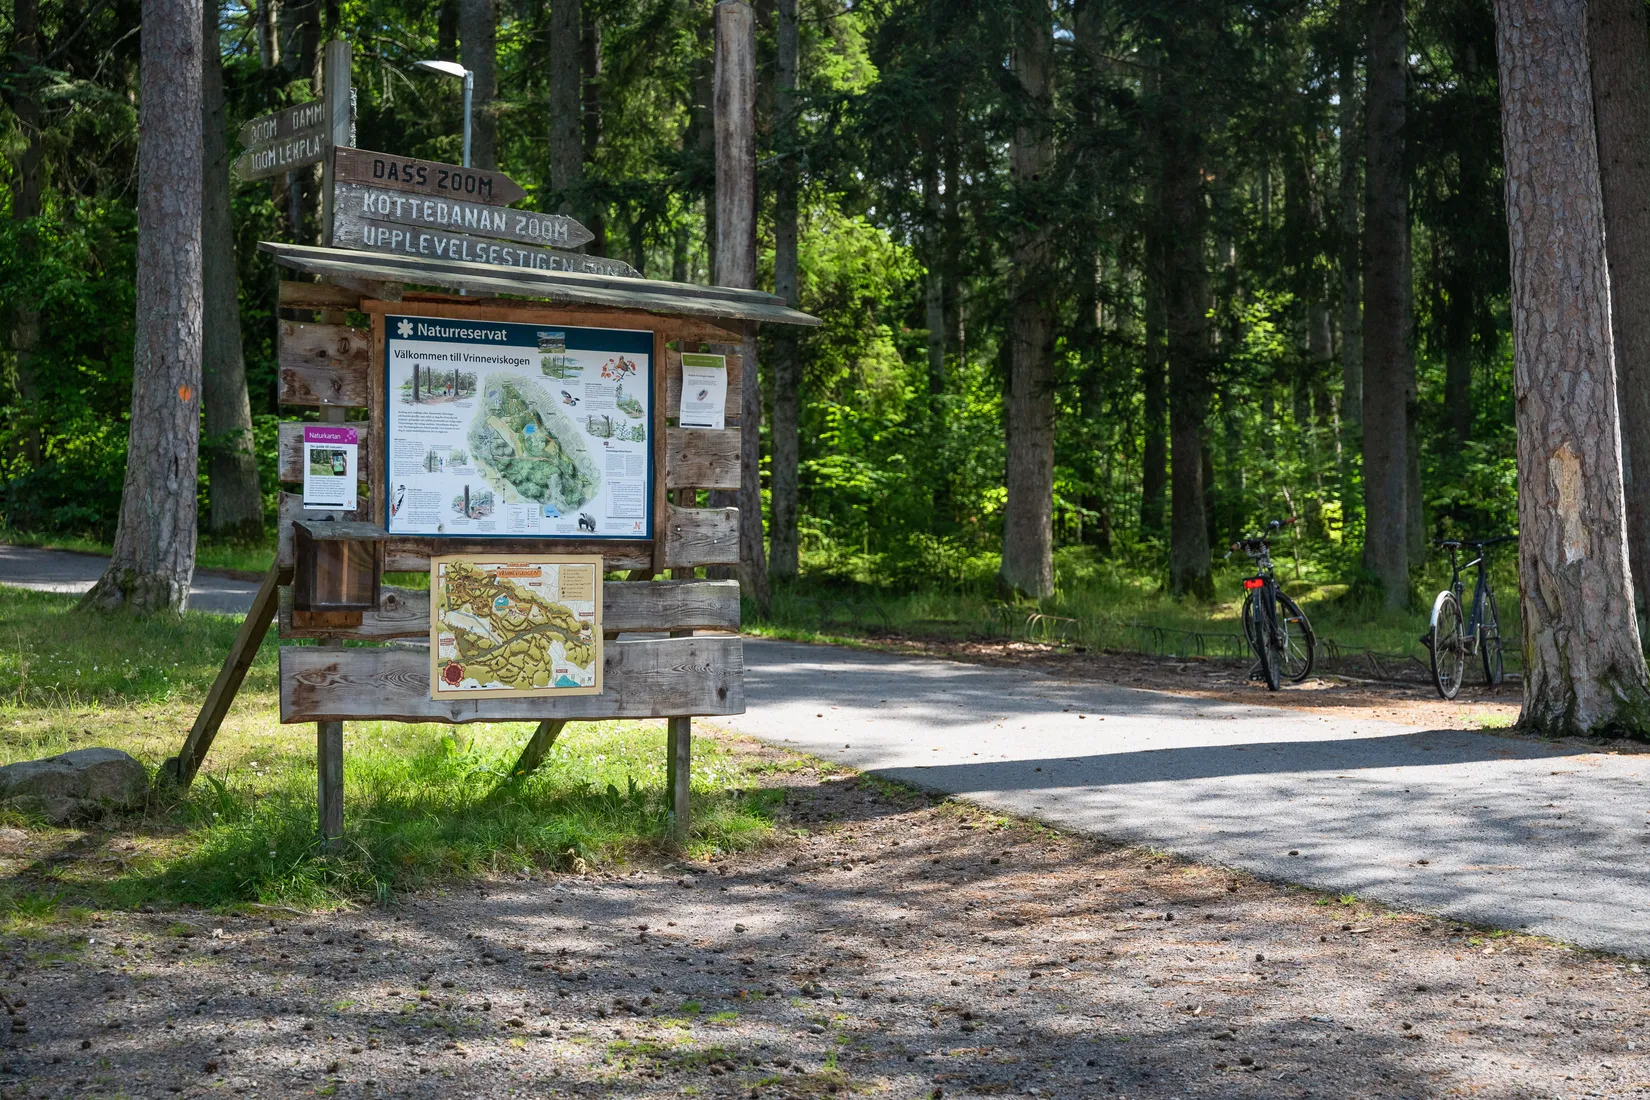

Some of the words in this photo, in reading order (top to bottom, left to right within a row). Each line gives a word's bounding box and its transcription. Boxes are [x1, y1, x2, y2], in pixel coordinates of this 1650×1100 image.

[373, 159, 428, 186] DASS
[363, 192, 507, 232] KOTTEBANAN
[417, 323, 508, 341] Naturreservat
[394, 349, 448, 362] Välkommen
[450, 352, 462, 362] till
[463, 353, 531, 367] Vrinneviskogen
[309, 432, 341, 440] Naturkartan
